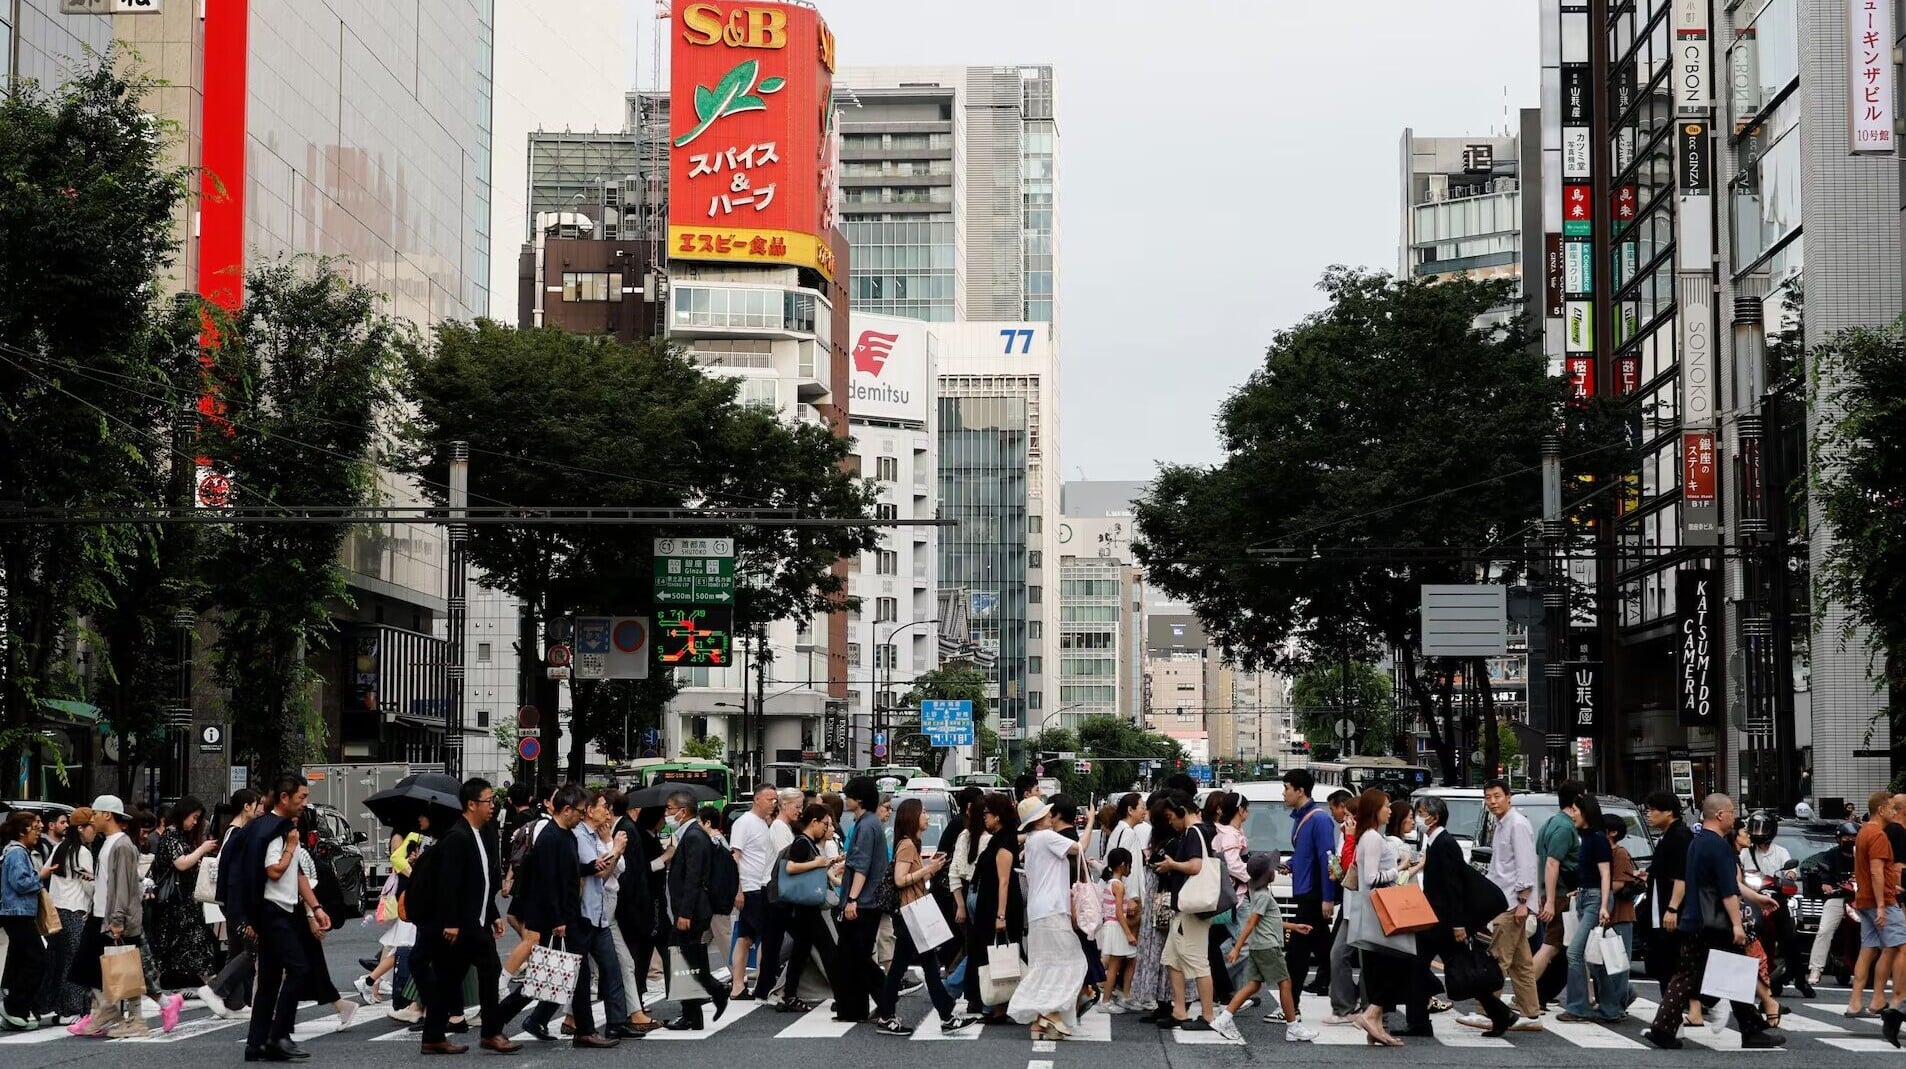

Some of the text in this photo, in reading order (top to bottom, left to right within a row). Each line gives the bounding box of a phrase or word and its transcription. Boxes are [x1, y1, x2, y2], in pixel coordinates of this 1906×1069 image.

[683, 3, 787, 49] S&B
[1685, 46, 1699, 100] C'BON
[1576, 133, 1586, 170] カツミ堂
[1857, 130, 1889, 140] 10号館
[688, 141, 780, 179] スパイス
[1688, 152, 1699, 187] GINZA
[730, 172, 750, 193] &
[680, 233, 786, 256] エスビー食品
[1000, 329, 1034, 354] 77
[1689, 322, 1706, 412] SONOKO
[1688, 446, 1698, 491] ステーキ
[1699, 438, 1711, 473] 銀座の
[1683, 619, 1696, 709] CAMERA
[1696, 580, 1710, 716] KATSUMIDO
[1576, 668, 1593, 725] 山形屋
